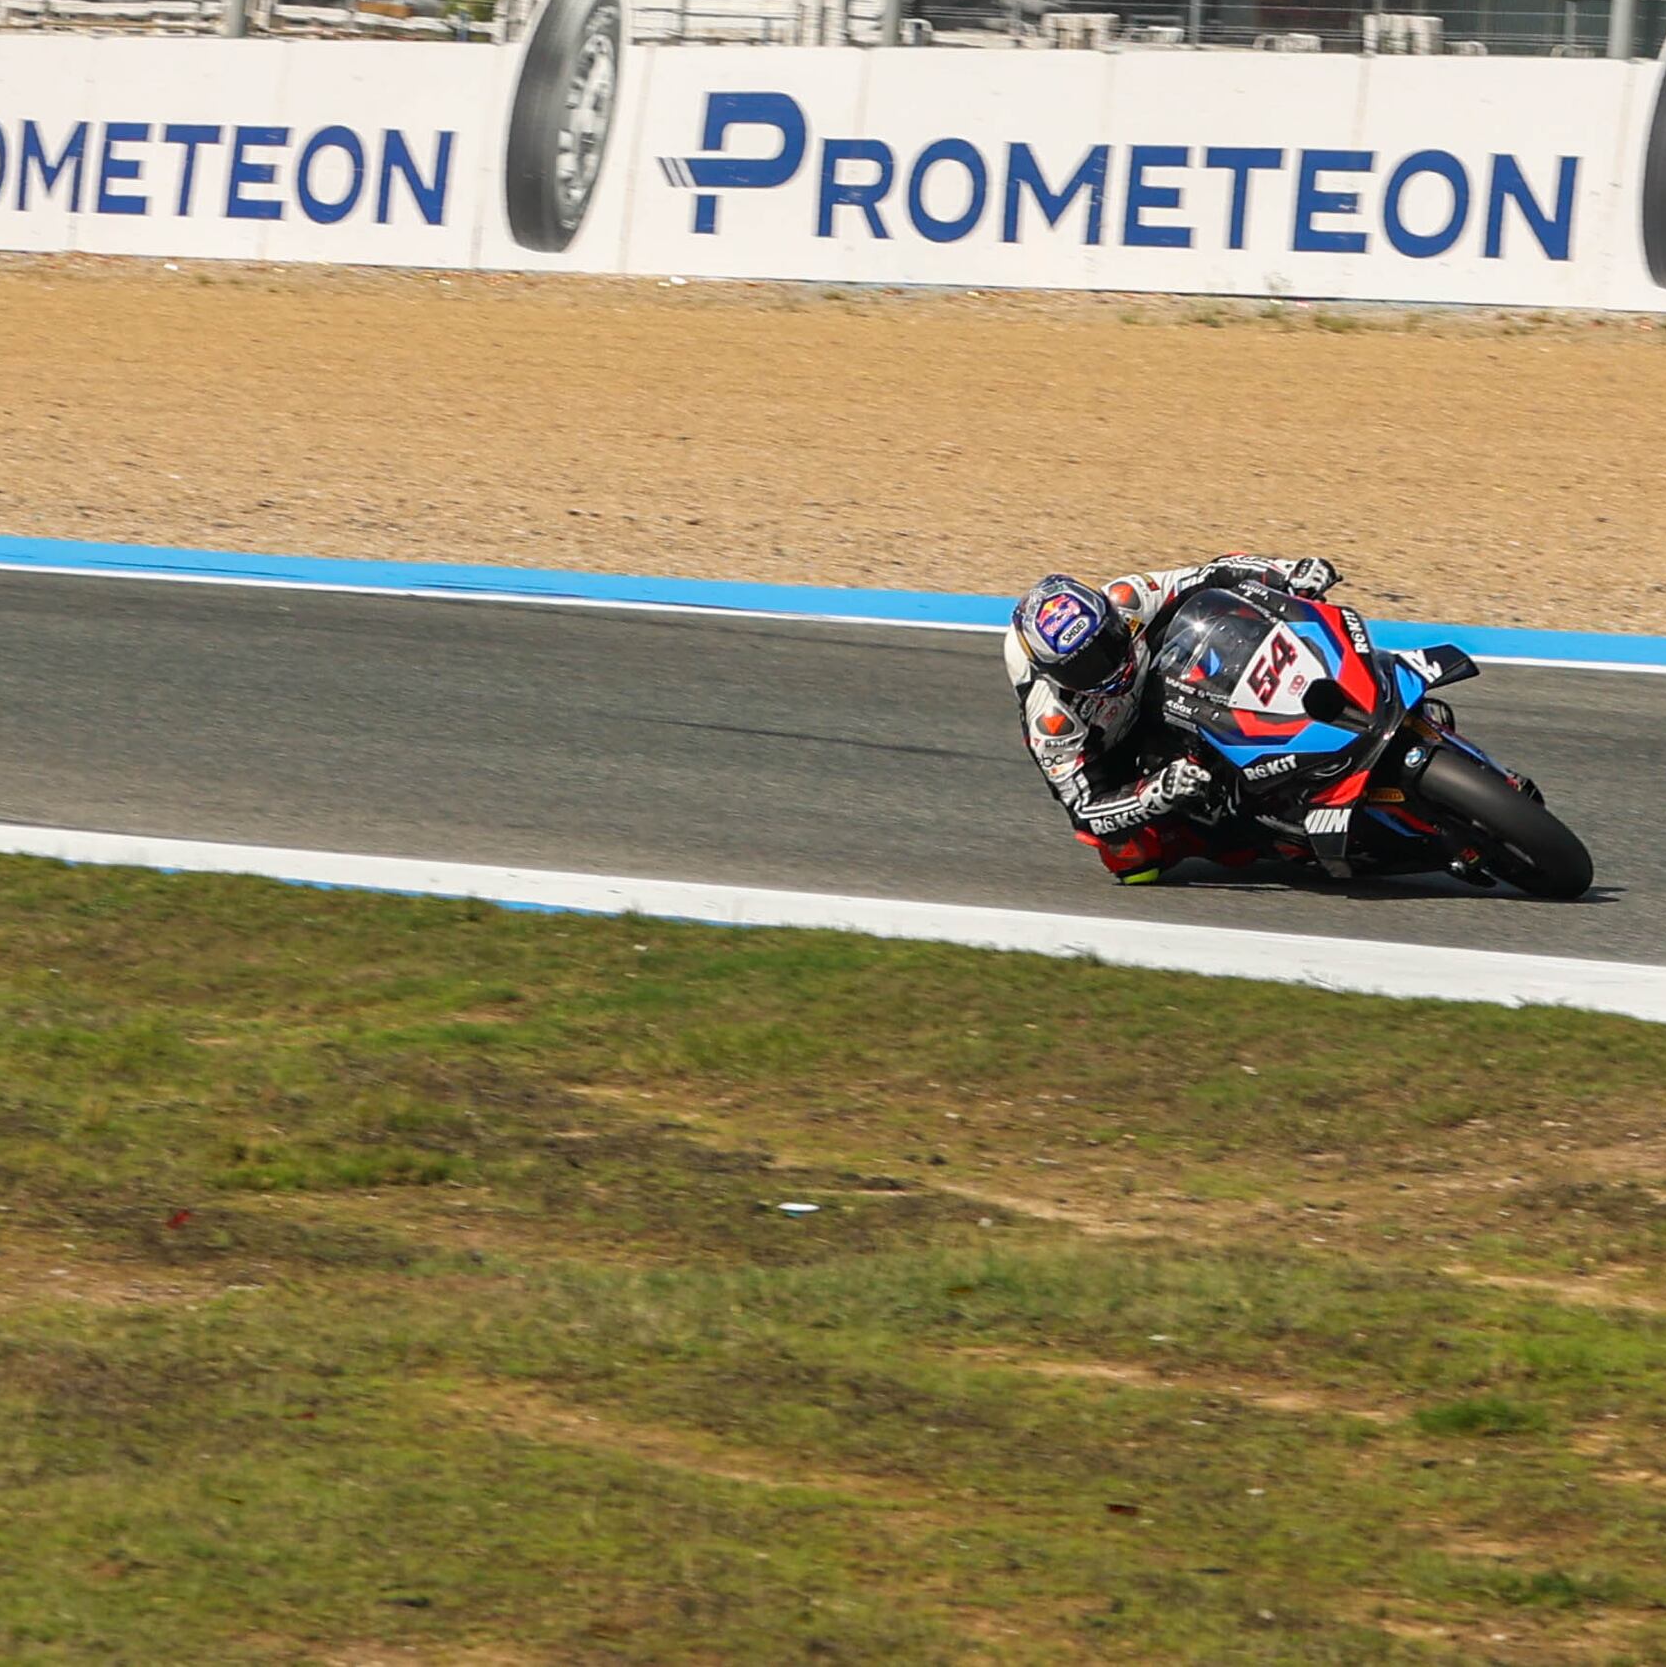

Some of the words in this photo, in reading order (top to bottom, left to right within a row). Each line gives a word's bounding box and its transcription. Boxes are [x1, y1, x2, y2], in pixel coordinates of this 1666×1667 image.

[659, 90, 1579, 263] PROMETEON
[1063, 620, 1086, 644] SHOEI
[1247, 631, 1298, 708] 54
